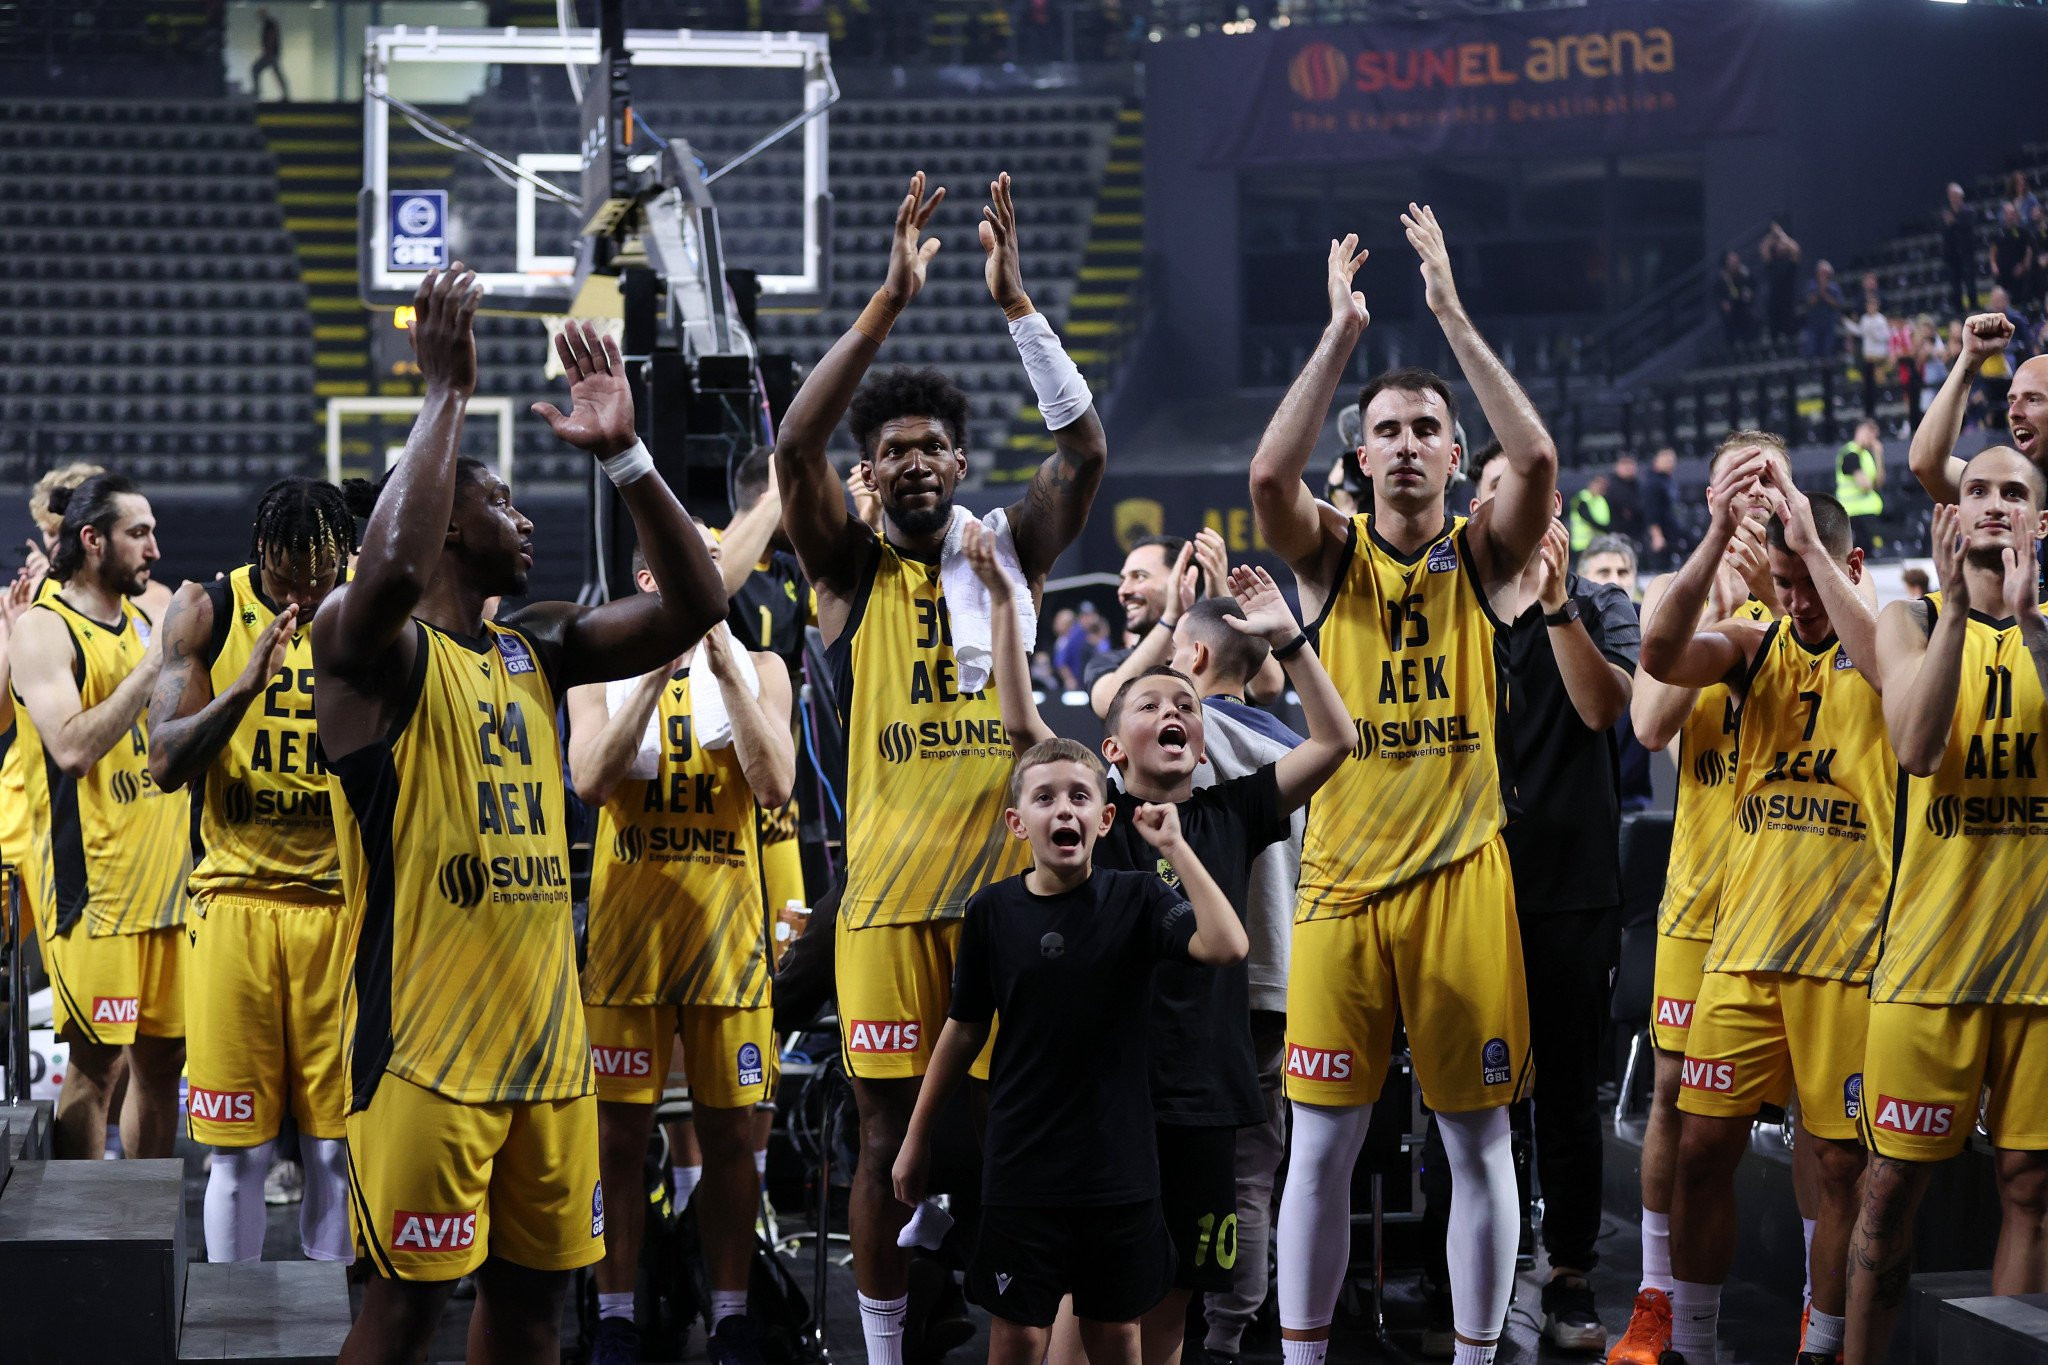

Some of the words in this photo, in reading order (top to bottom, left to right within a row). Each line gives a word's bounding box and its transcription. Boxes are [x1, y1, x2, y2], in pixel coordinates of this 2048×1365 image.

[1354, 43, 1519, 93] SUNEL
[1525, 27, 1674, 83] arena
[1203, 508, 1268, 551] AE
[1430, 560, 1455, 571] GBL
[1387, 594, 1429, 652] 15
[507, 660, 533, 672] GBL
[1836, 658, 1853, 668] GB
[1378, 655, 1450, 704] AEK
[1985, 665, 2012, 720] 11
[1381, 715, 1480, 747] SUNEL
[1799, 691, 1822, 741] 7
[478, 700, 532, 767] 24
[668, 715, 692, 762] 9
[920, 744, 986, 759] Empowering
[1380, 746, 1446, 760] Empowering
[1765, 748, 1838, 785] AEK
[1964, 733, 2038, 779] AEK
[477, 781, 546, 835] AEK
[644, 772, 716, 814] AEK
[1767, 795, 1867, 829] SUNEL
[1964, 796, 2048, 823] SUNE
[649, 827, 745, 855] SUNEL
[1767, 821, 1825, 836] Empowering
[1827, 826, 1866, 842] Change
[491, 856, 567, 888] SUNEL
[648, 853, 711, 866] Empowering
[493, 890, 553, 904] Empowering
[94, 999, 138, 1022] AVIS
[1658, 1000, 1697, 1025] AV
[851, 1024, 919, 1050] AVIS
[740, 1073, 762, 1085] GBL
[1288, 1048, 1350, 1079] AVIS
[1486, 1071, 1509, 1084] GBL
[1681, 1060, 1733, 1090] AVIS
[191, 1090, 252, 1120] AVIS
[1877, 1101, 1952, 1134] AVIS
[395, 1214, 476, 1248] AVIS
[1195, 1212, 1237, 1270] 10
